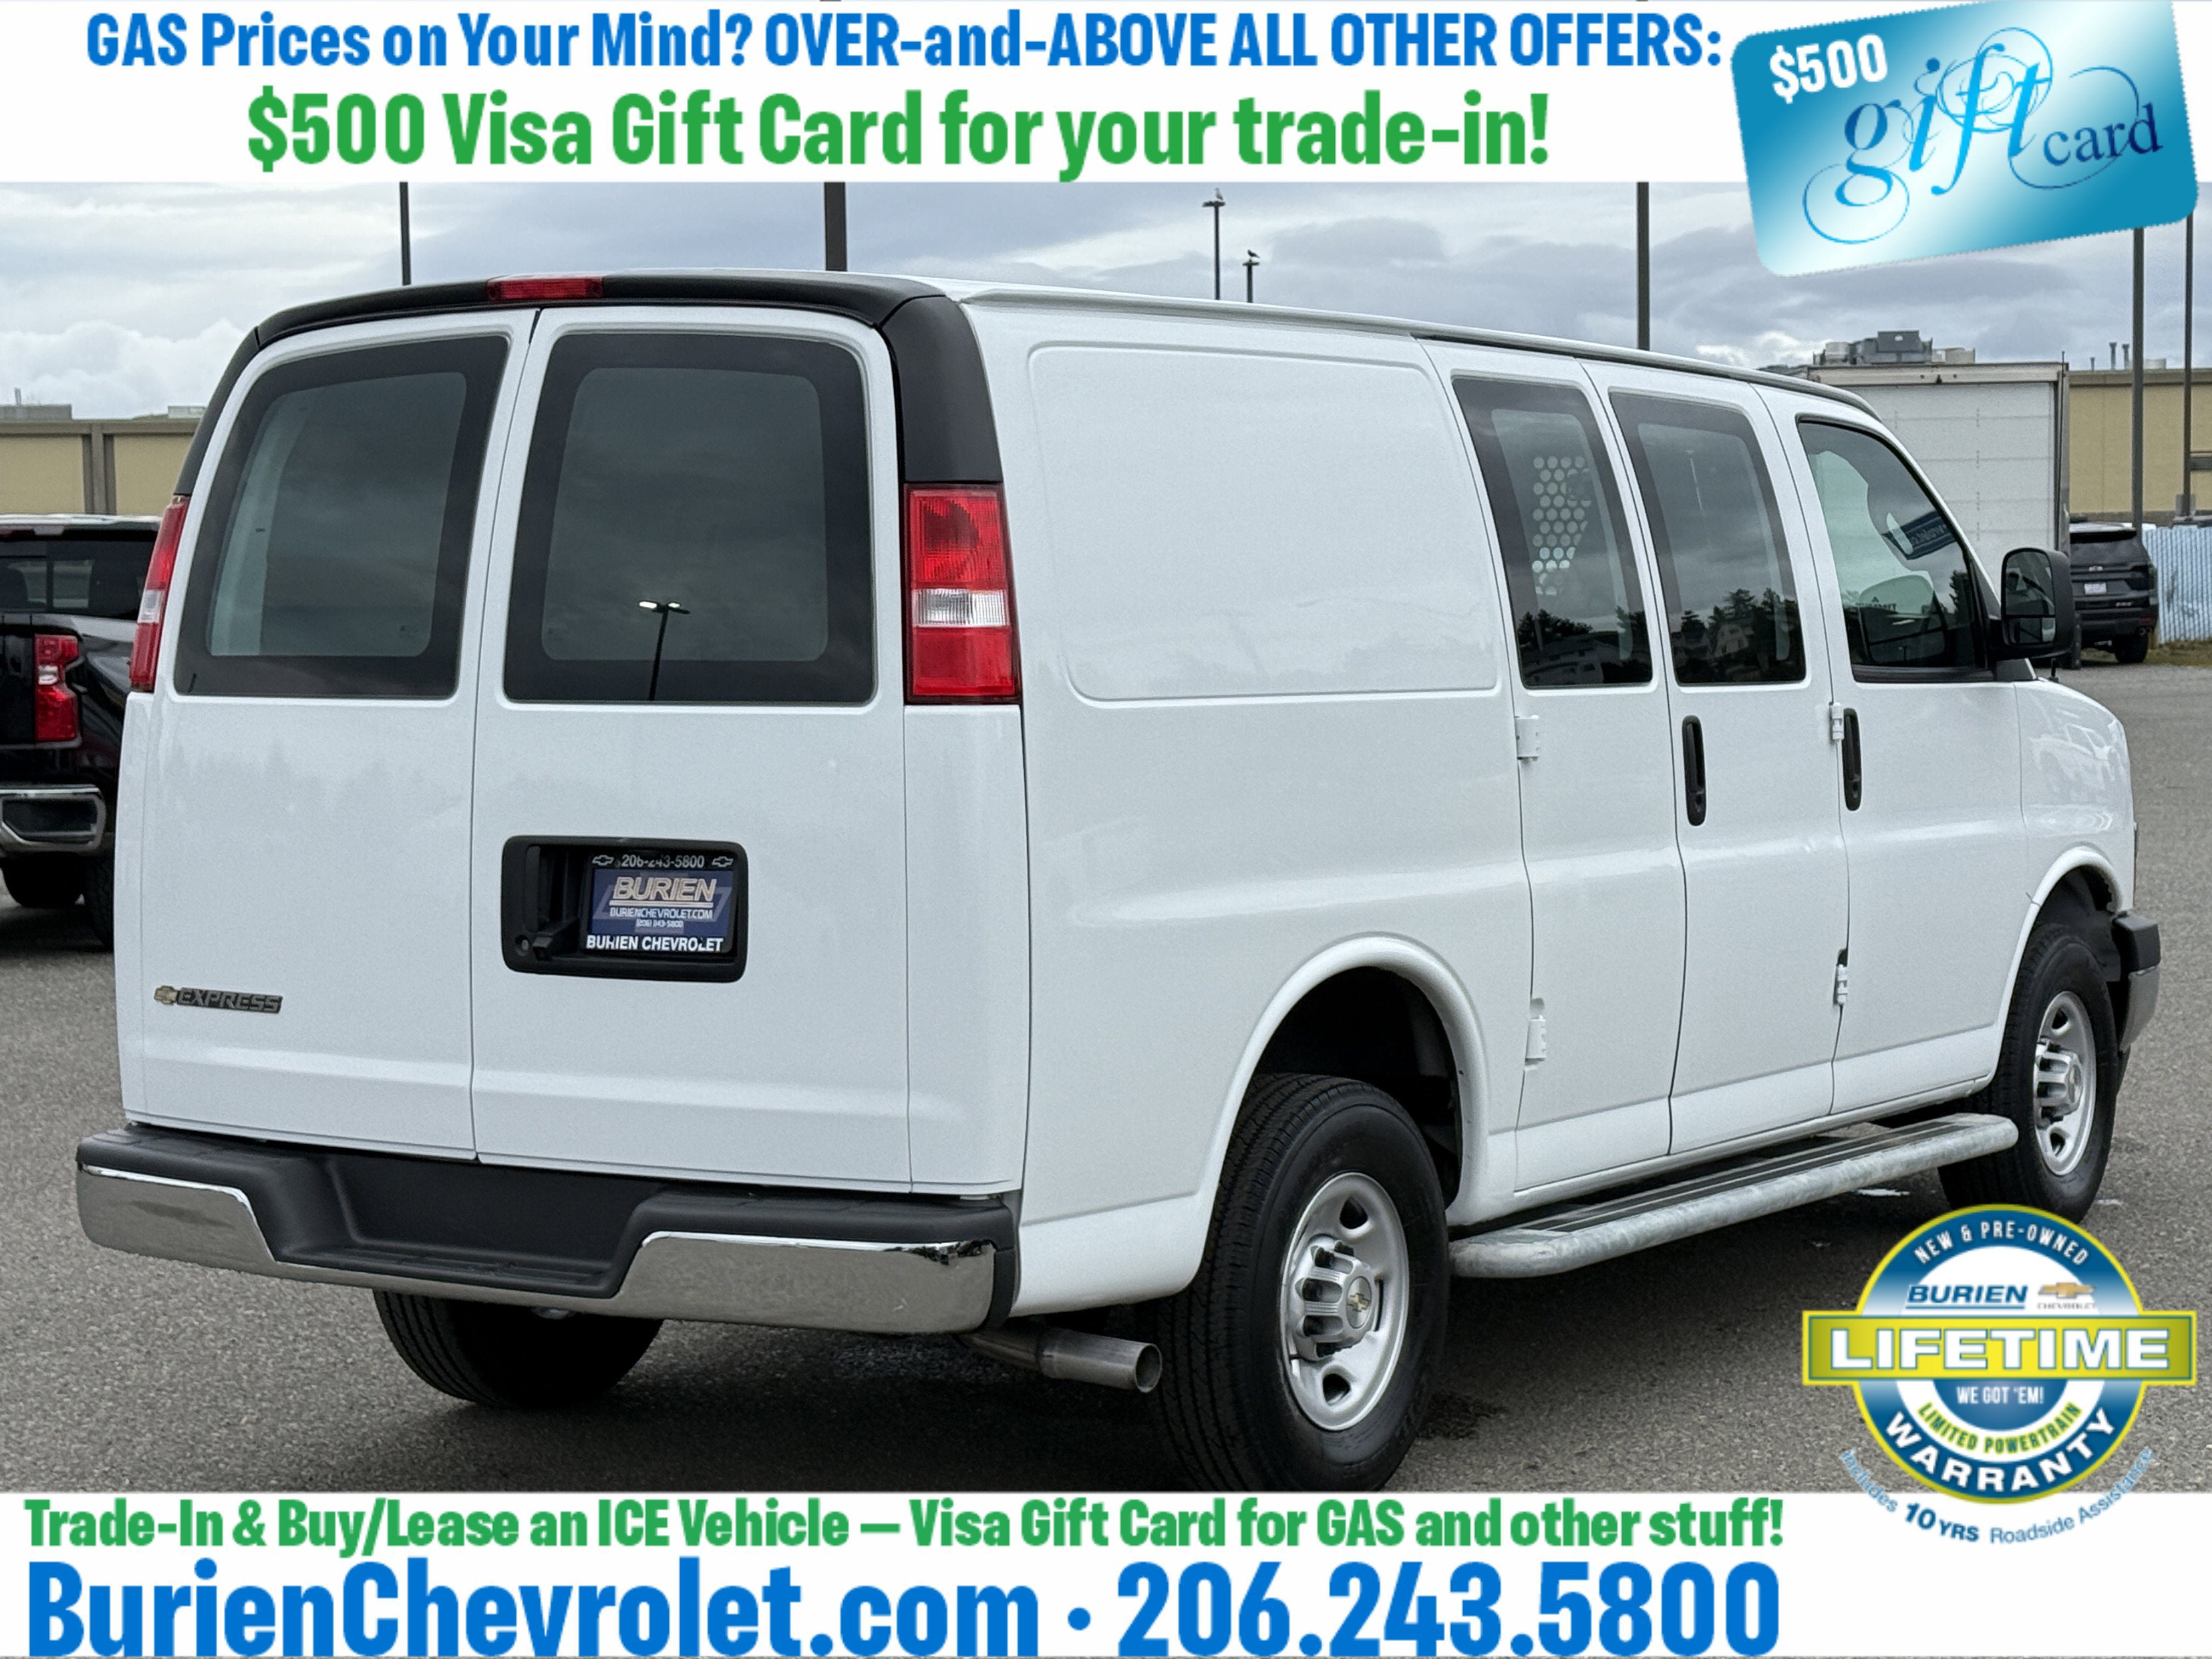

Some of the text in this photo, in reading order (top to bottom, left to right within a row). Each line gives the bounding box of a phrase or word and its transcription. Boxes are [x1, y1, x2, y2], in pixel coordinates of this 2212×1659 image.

[612, 877, 717, 901] BURIEN
[586, 935, 638, 950] BURIEN
[177, 988, 281, 1013] EXPRESS
